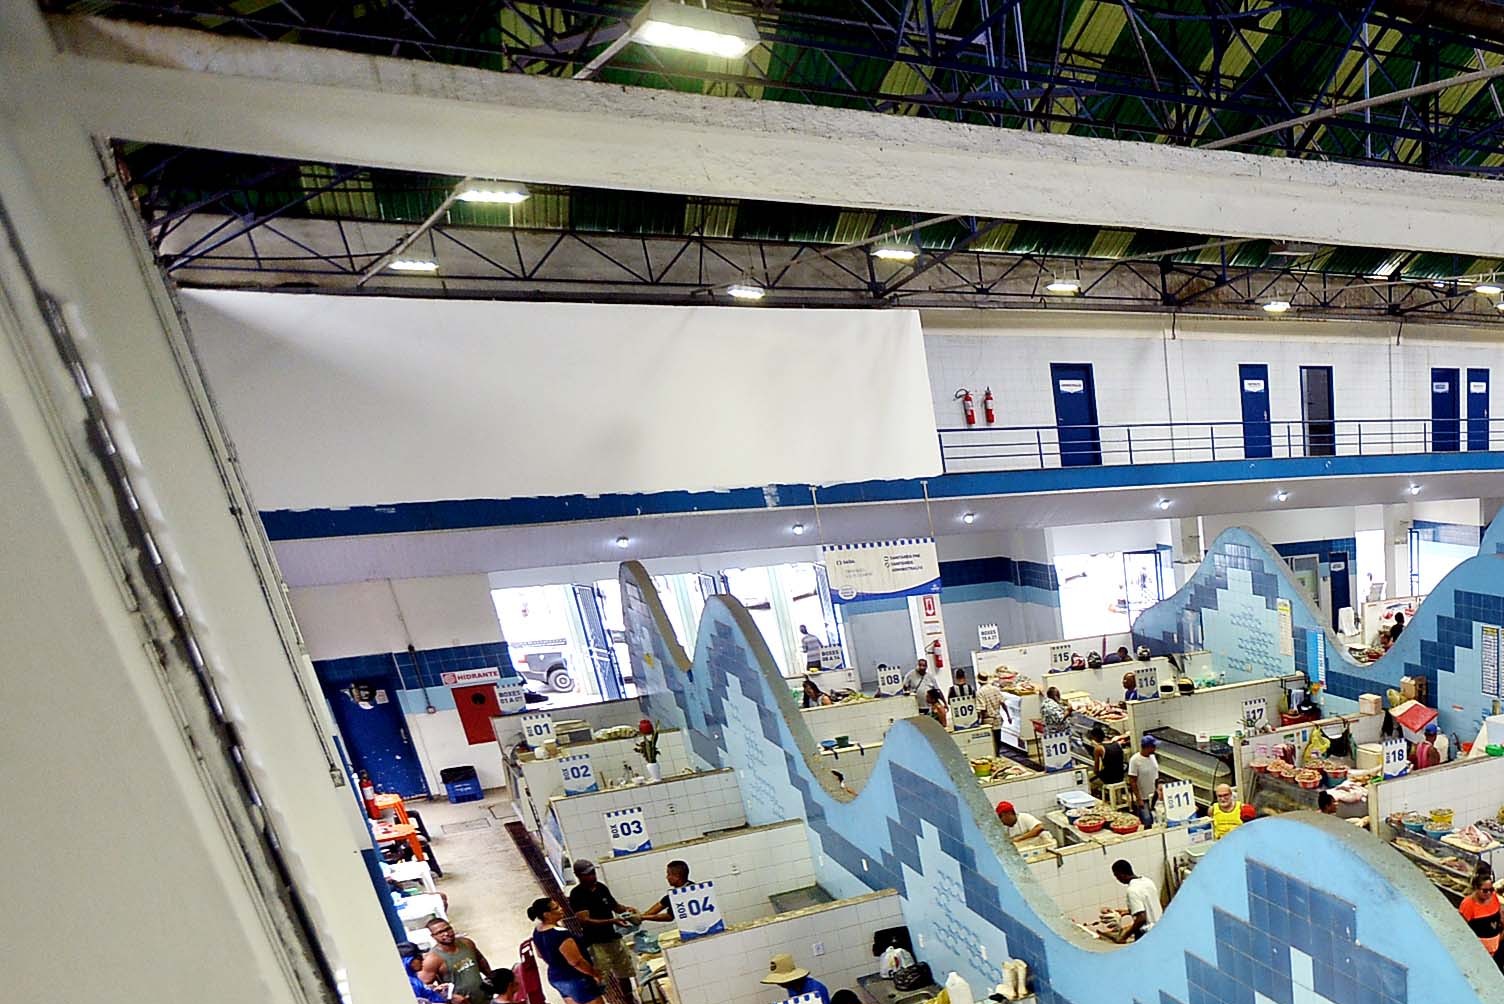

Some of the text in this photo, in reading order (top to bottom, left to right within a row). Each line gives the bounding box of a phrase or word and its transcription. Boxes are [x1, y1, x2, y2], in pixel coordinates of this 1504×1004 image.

[1058, 652, 1069, 662] 15
[457, 670, 498, 682] HIDRANTE
[886, 674, 900, 685] 08
[1143, 675, 1156, 687] 16
[960, 704, 974, 717] 09
[1251, 708, 1264, 720] 17
[534, 723, 551, 736] 01
[1052, 742, 1067, 756] 10
[1391, 749, 1404, 763] 18
[570, 765, 591, 779] 02
[1174, 791, 1190, 807] 11
[609, 820, 643, 839] BOX 03
[676, 896, 715, 919] BOX 04
